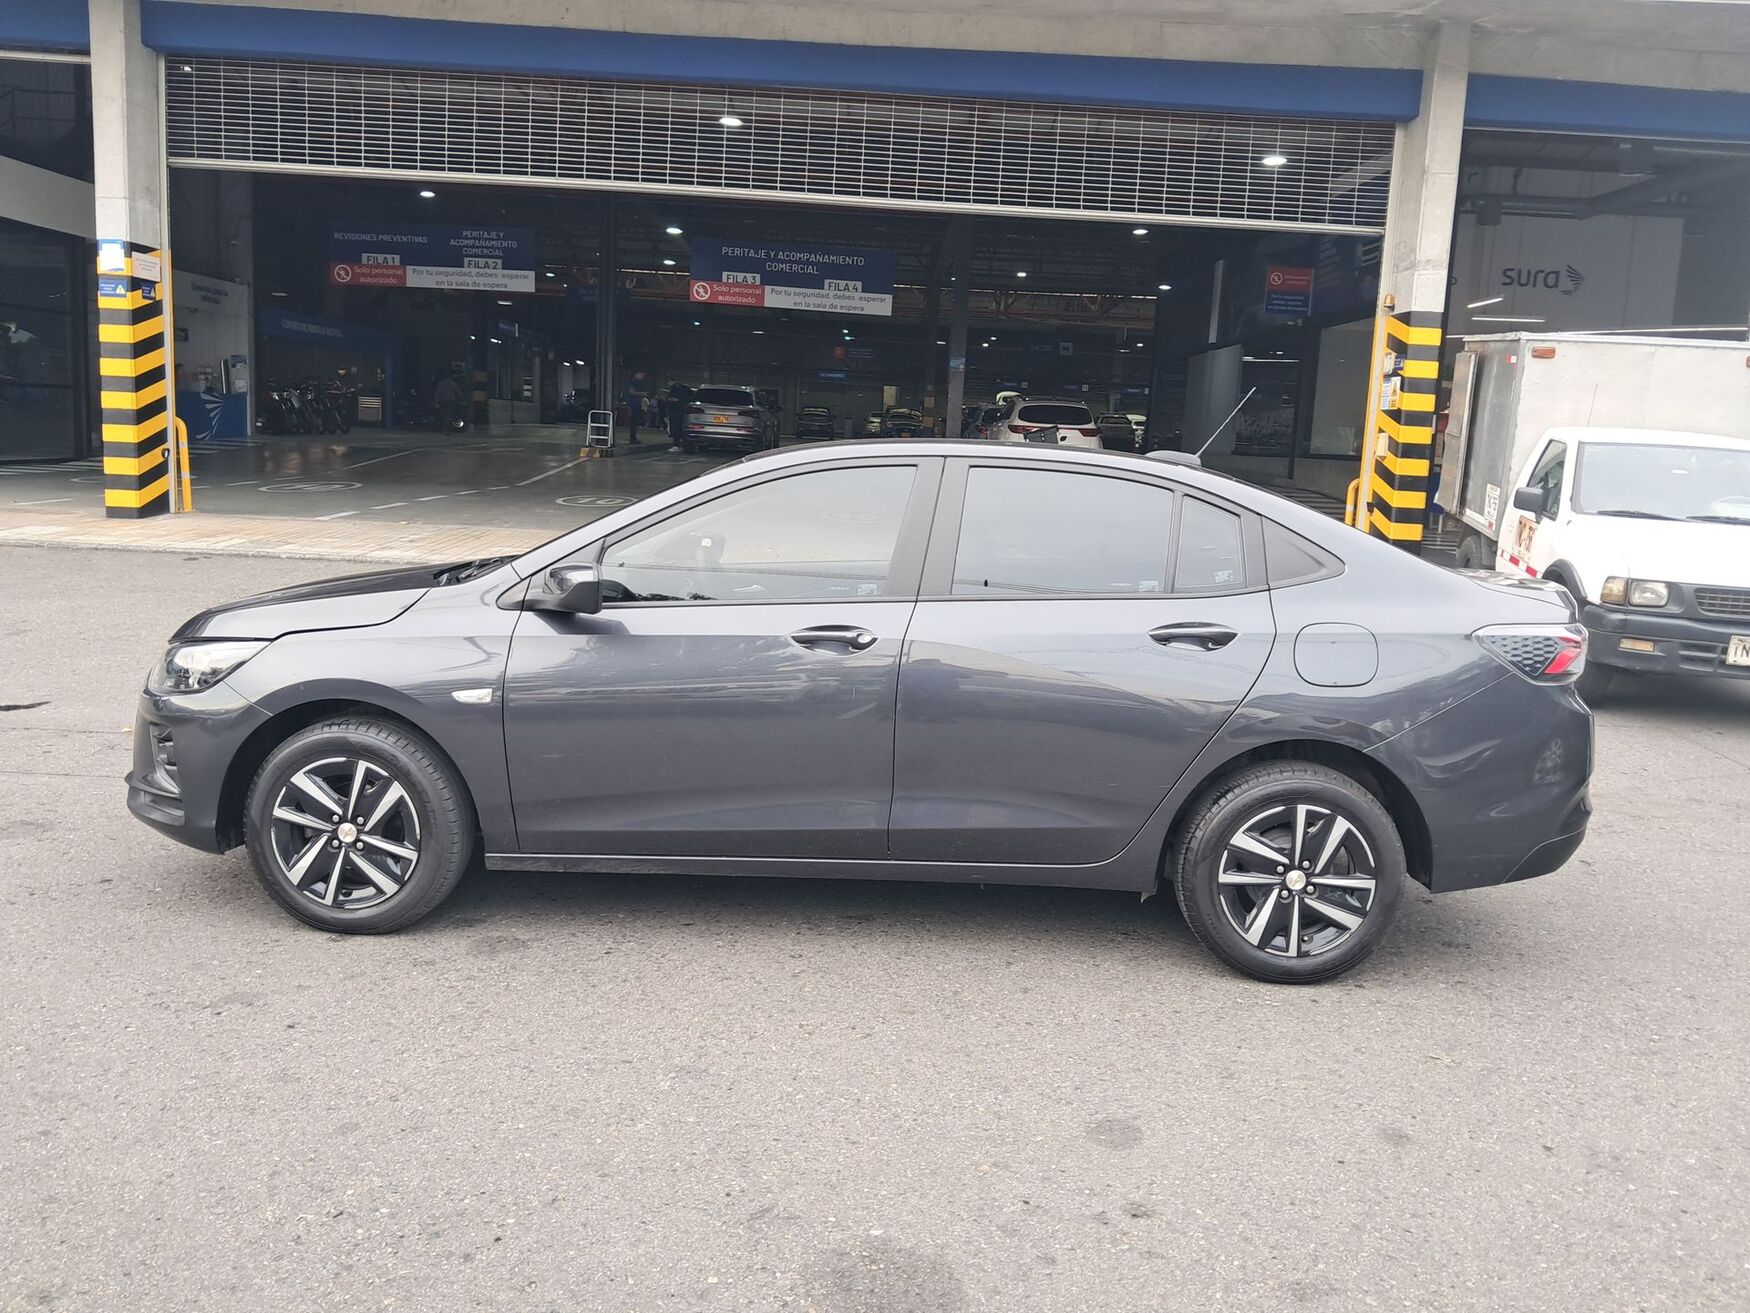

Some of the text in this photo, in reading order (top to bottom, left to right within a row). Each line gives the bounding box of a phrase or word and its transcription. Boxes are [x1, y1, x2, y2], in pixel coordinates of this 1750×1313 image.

[334, 232, 428, 243] REVISIONES PREVENTIVAS
[462, 230, 504, 239] PERITAJE Y
[449, 238, 518, 249] ACOMPAÑAMIENTO
[462, 248, 504, 256] COMERCIAL
[722, 246, 865, 266] PERITAJE Y ACOMPAÑAMIENTO
[366, 255, 390, 265] FILA
[467, 259, 499, 269] FILA 2
[353, 265, 404, 276] Solo personal
[765, 262, 820, 275] COMERCIAL
[359, 276, 398, 284] autorizado
[412, 267, 424, 276] Por
[501, 273, 529, 282] esperar
[726, 273, 757, 284] FILA 3
[1501, 267, 1561, 289] sura
[446, 279, 454, 287] la
[454, 280, 470, 288] sala
[471, 280, 481, 288] de
[482, 282, 508, 290] espera
[712, 284, 762, 295] Solo personal
[827, 281, 859, 292] FILA 4
[718, 295, 756, 304] autorizado
[770, 287, 784, 296] Por
[784, 288, 792, 297] tu
[832, 291, 856, 301] debes
[858, 295, 887, 304] esperar
[812, 301, 827, 309] sala
[828, 301, 838, 310] de
[839, 304, 865, 312] espera
